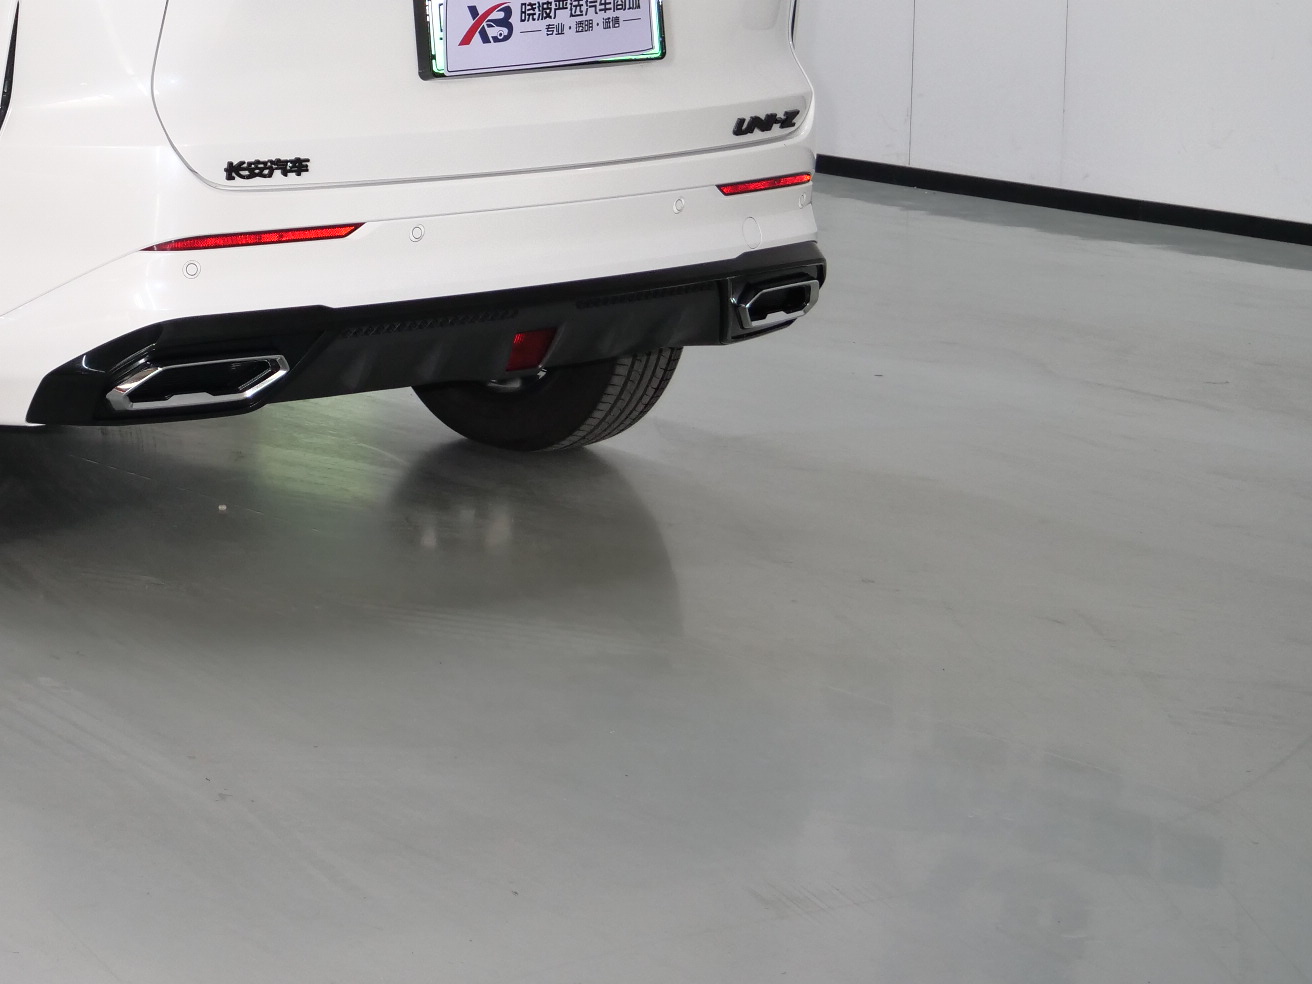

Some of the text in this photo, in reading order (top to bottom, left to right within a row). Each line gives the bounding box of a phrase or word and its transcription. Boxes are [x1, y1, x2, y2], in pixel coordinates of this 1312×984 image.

[732, 109, 800, 136] UNI-Z
[224, 157, 310, 181] 长安汽车
